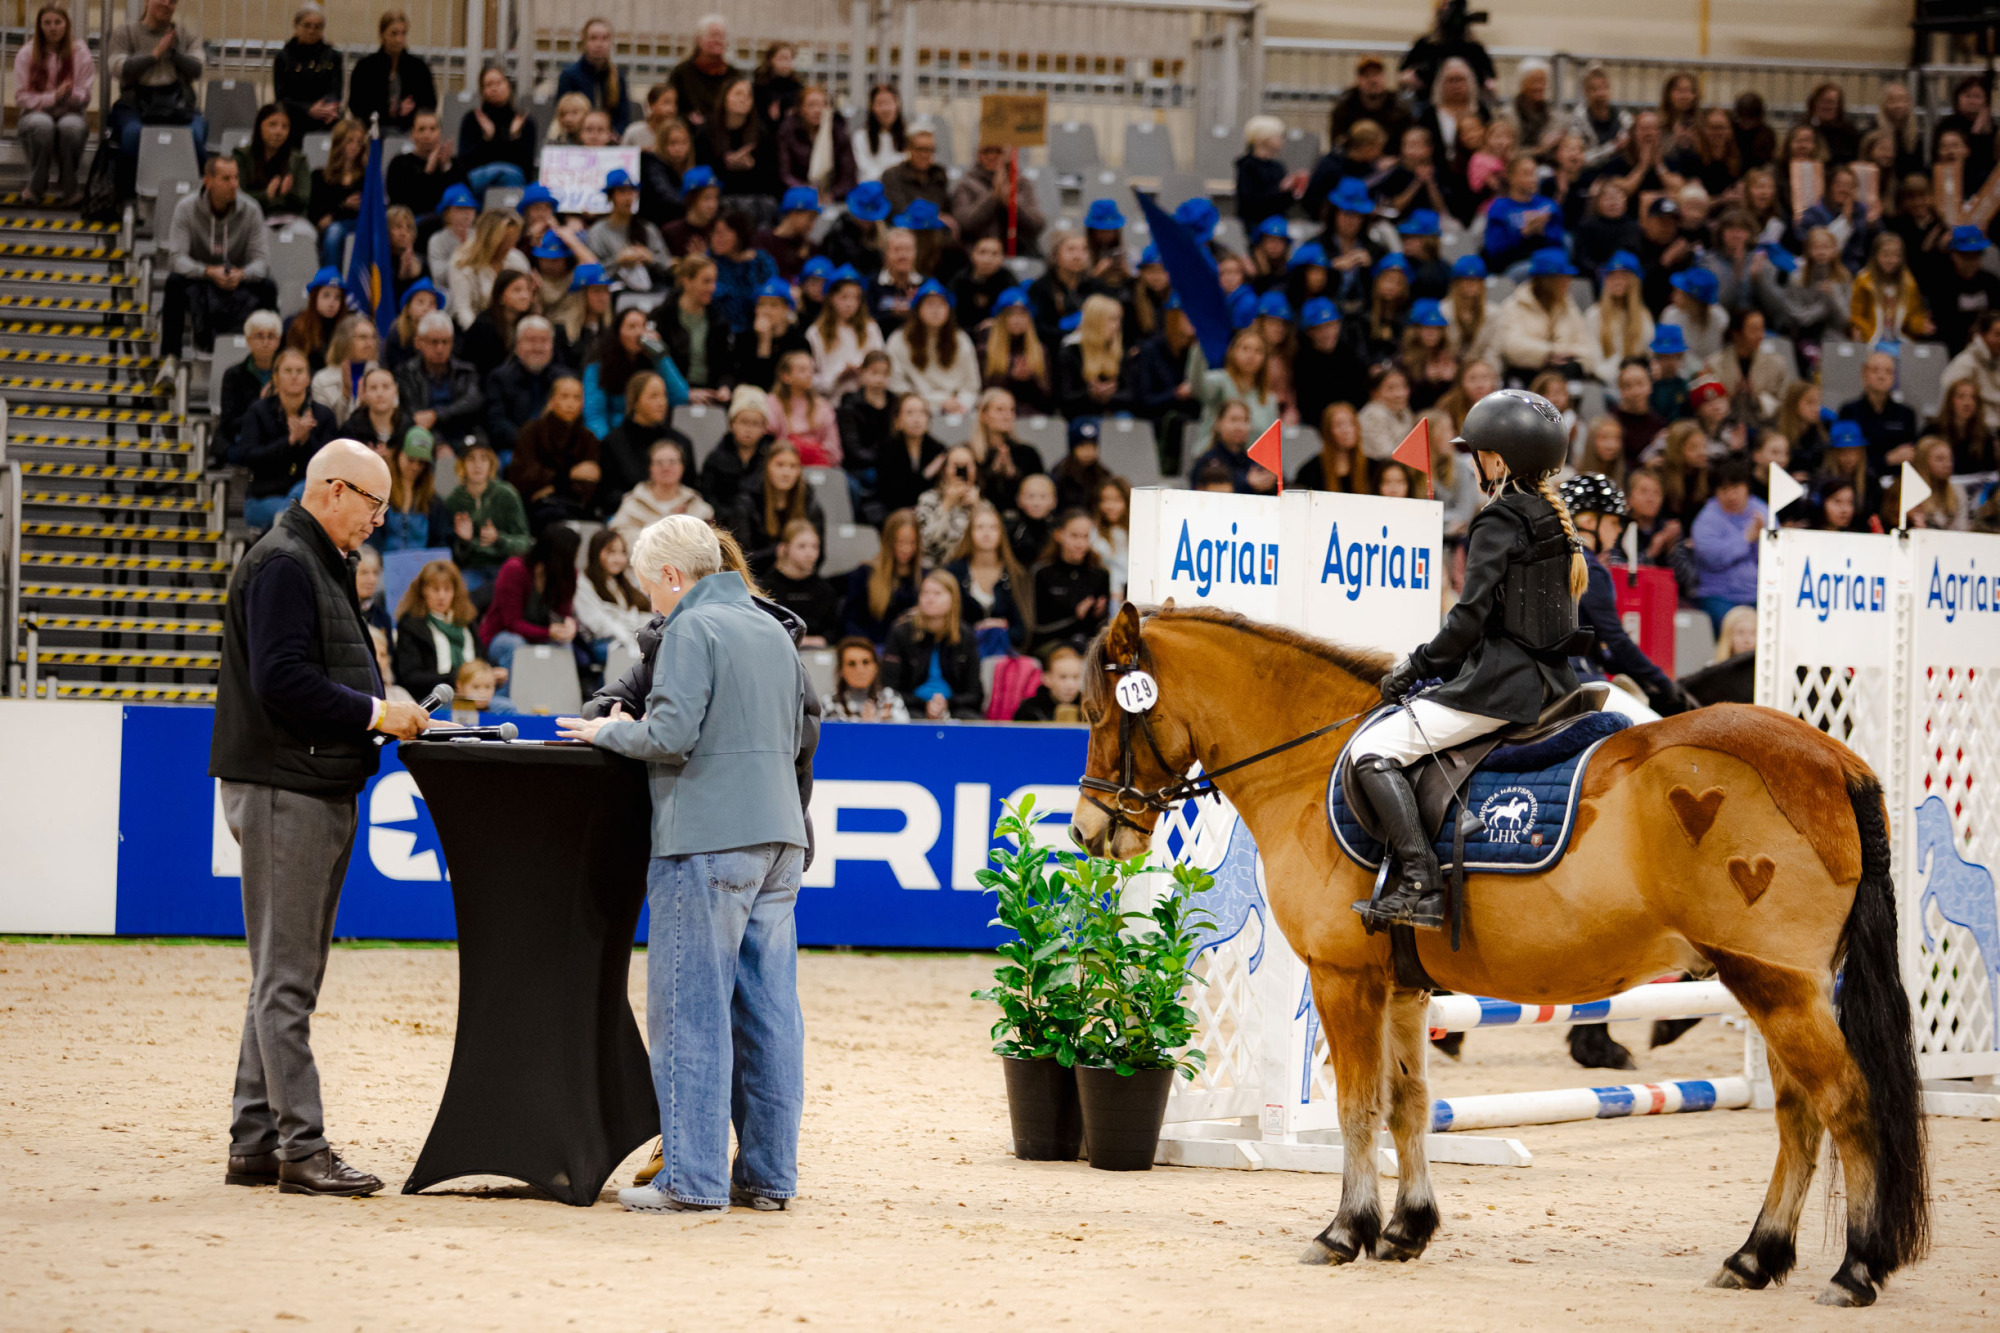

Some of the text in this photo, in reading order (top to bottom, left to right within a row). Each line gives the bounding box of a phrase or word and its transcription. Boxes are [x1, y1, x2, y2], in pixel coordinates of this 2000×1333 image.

[1171, 518, 1256, 597] Agria
[1320, 521, 1405, 601] Agria
[1797, 556, 1866, 622] Agria
[1927, 556, 1988, 623] Agria
[1120, 678, 1152, 706] 729
[1488, 829, 1521, 844] LHK
